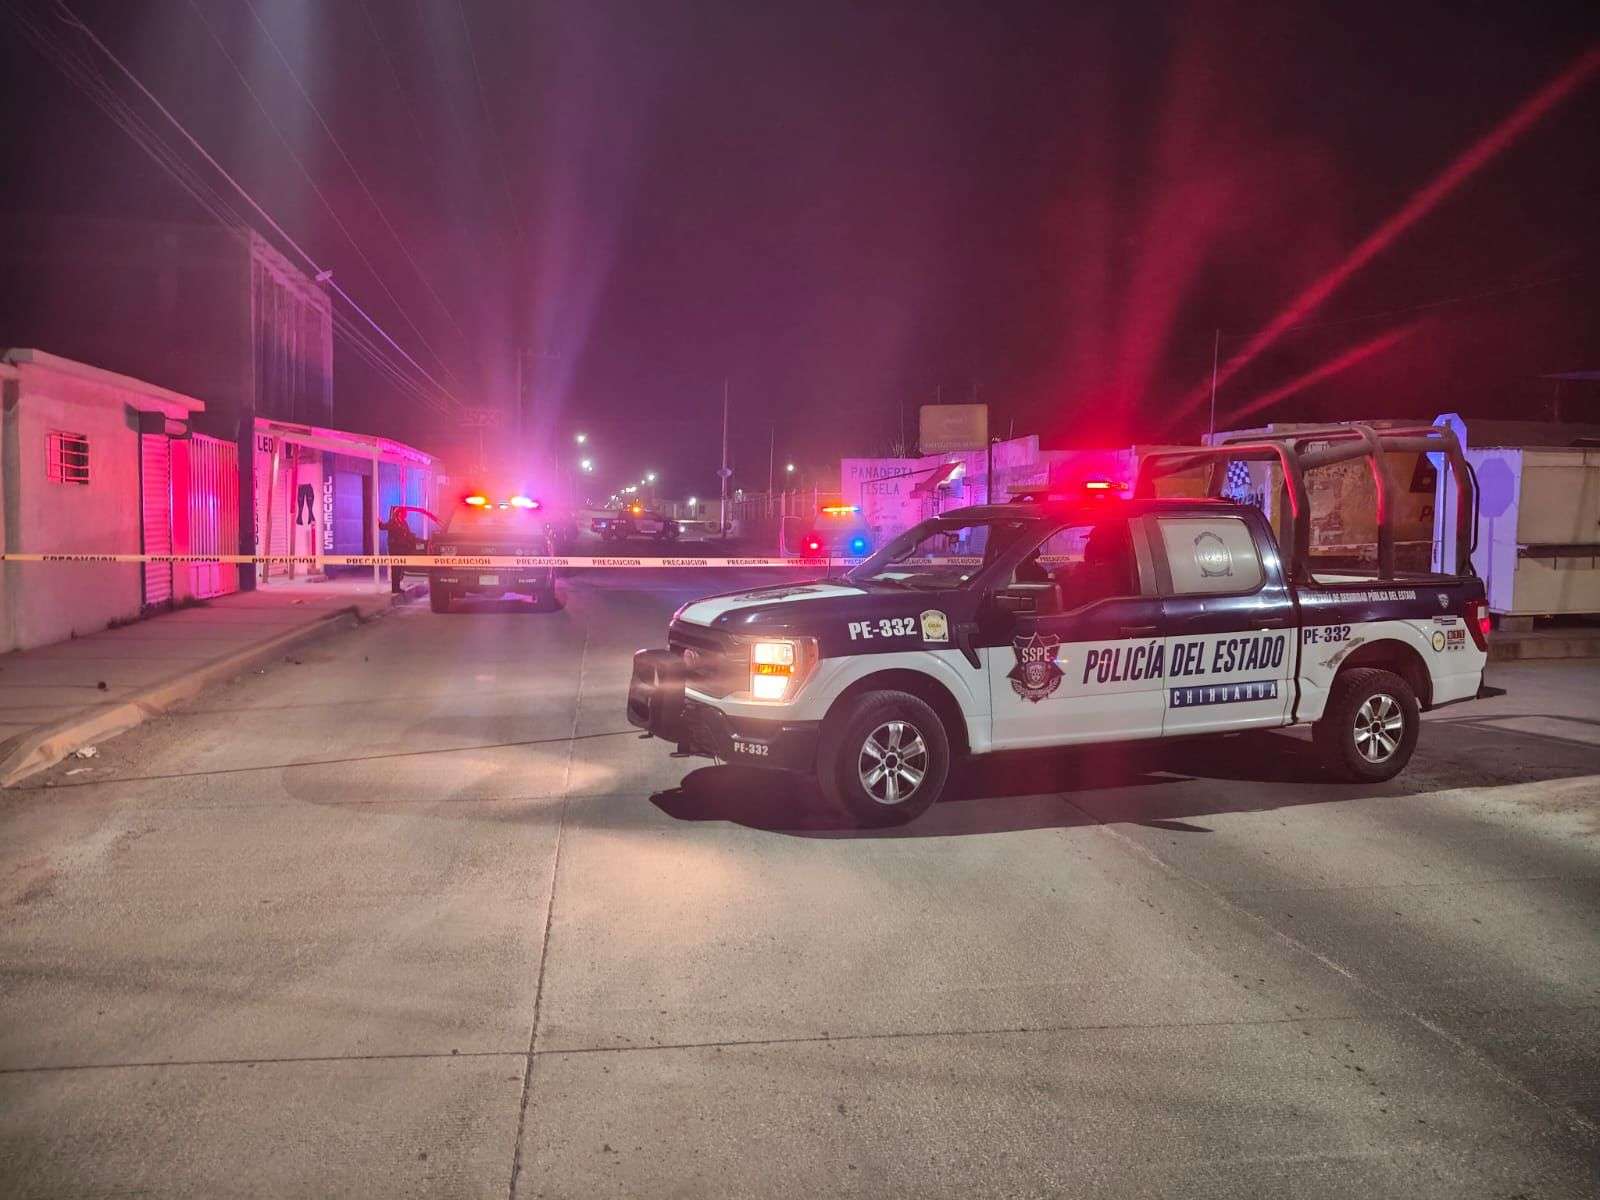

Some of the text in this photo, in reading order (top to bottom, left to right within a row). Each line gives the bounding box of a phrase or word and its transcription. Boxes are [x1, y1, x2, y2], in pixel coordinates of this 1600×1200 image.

[323, 475, 334, 550] JUGUETES
[515, 558, 569, 566] PRECAUCION
[1368, 590, 1388, 601] PÚBLICA
[1388, 591, 1398, 600] DEL
[1399, 590, 1416, 600] ESTADO
[848, 617, 917, 640] PE-332
[1303, 625, 1351, 645] PE-332
[1022, 646, 1051, 663] SSPE
[1082, 635, 1285, 684] POLICÍA DEL ESTADO
[1173, 683, 1276, 705] CHIHUAHUA
[734, 741, 769, 756] PE-332
